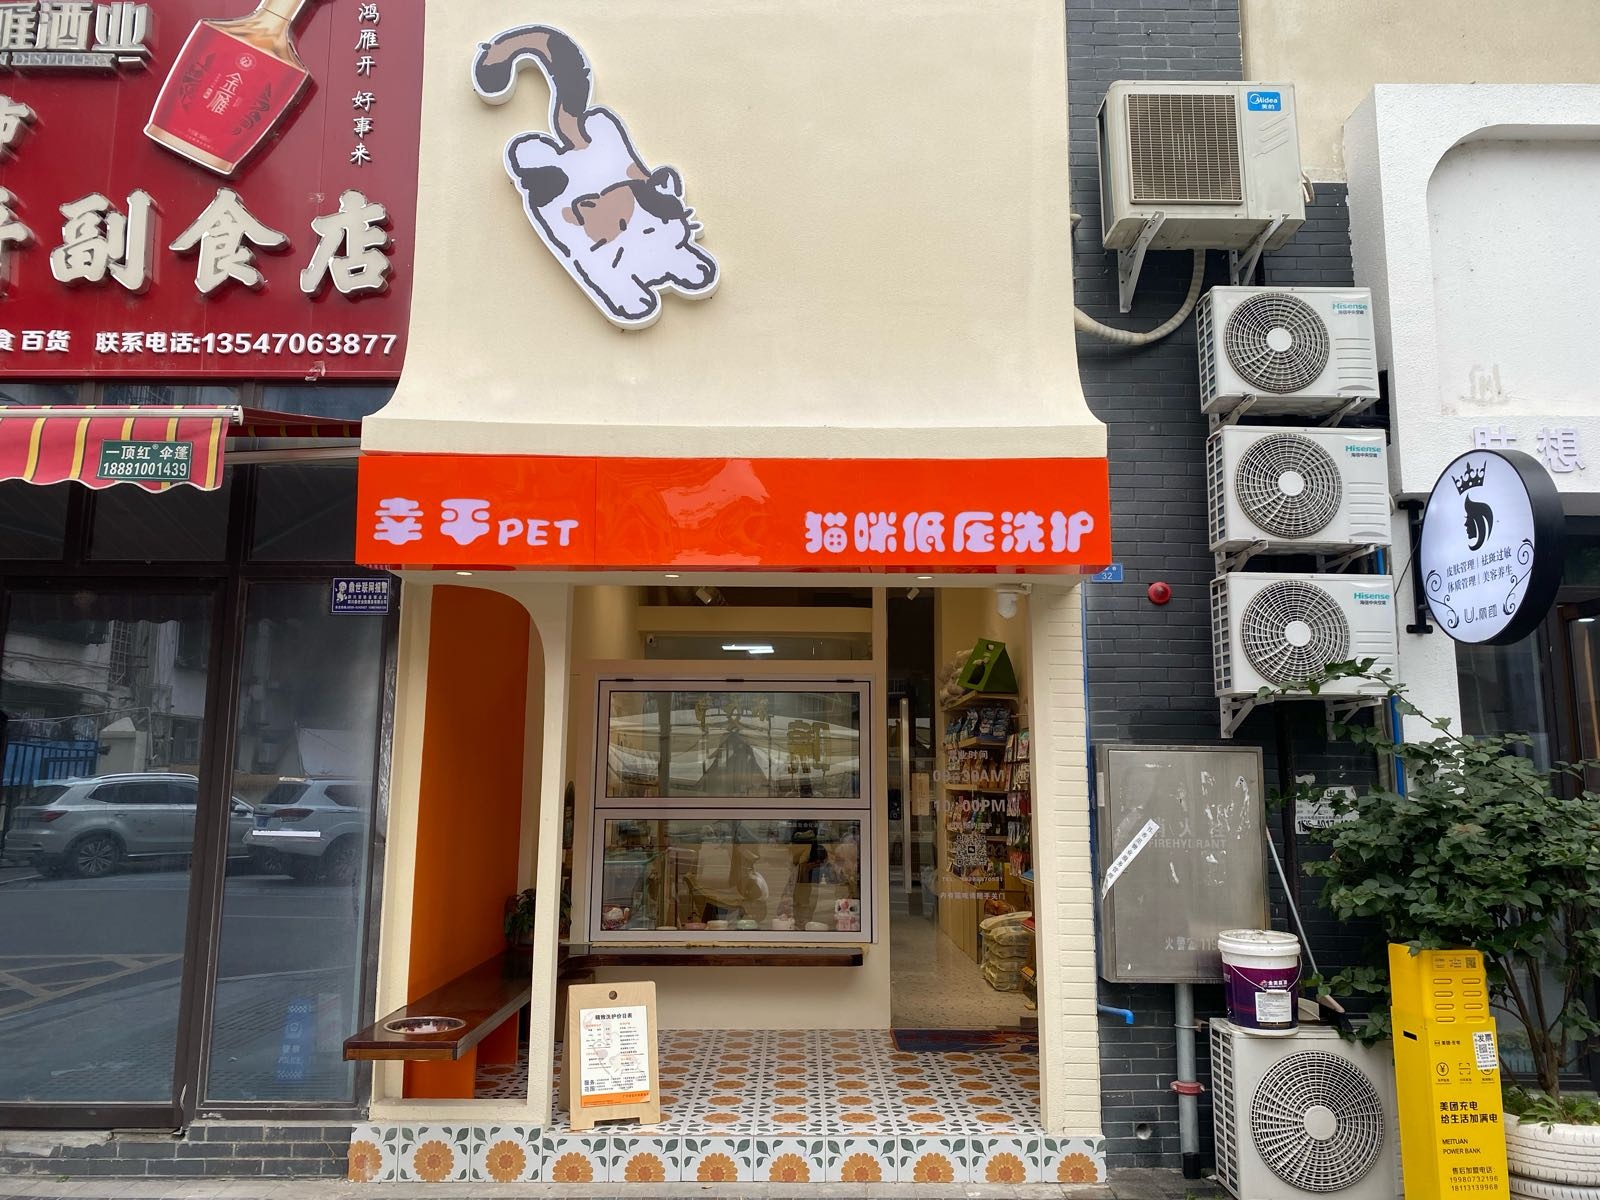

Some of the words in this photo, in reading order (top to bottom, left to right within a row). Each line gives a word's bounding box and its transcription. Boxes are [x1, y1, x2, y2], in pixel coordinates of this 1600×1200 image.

[354, 3, 380, 77] 鸿雁开
[1254, 96, 1279, 104] Midea
[350, 91, 375, 166] 好事来
[21, 331, 71, 354] 百货
[95, 331, 397, 356] 联系电话:13547063877
[1345, 444, 1382, 453] Hisense
[103, 462, 187, 477] 18881001439
[498, 518, 579, 546] PET
[805, 511, 1094, 553] 猫咪低压洗护
[1447, 559, 1475, 577] 皮肤管理
[1481, 546, 1511, 566] 祛斑过敏
[1102, 572, 1113, 580] 32
[1447, 574, 1476, 593] 体质管理
[1483, 564, 1513, 583] 美容养生
[1353, 592, 1390, 600] Hisense
[1440, 1101, 1478, 1111] 美团充电
[1440, 1113, 1498, 1124] 给生活加满电
